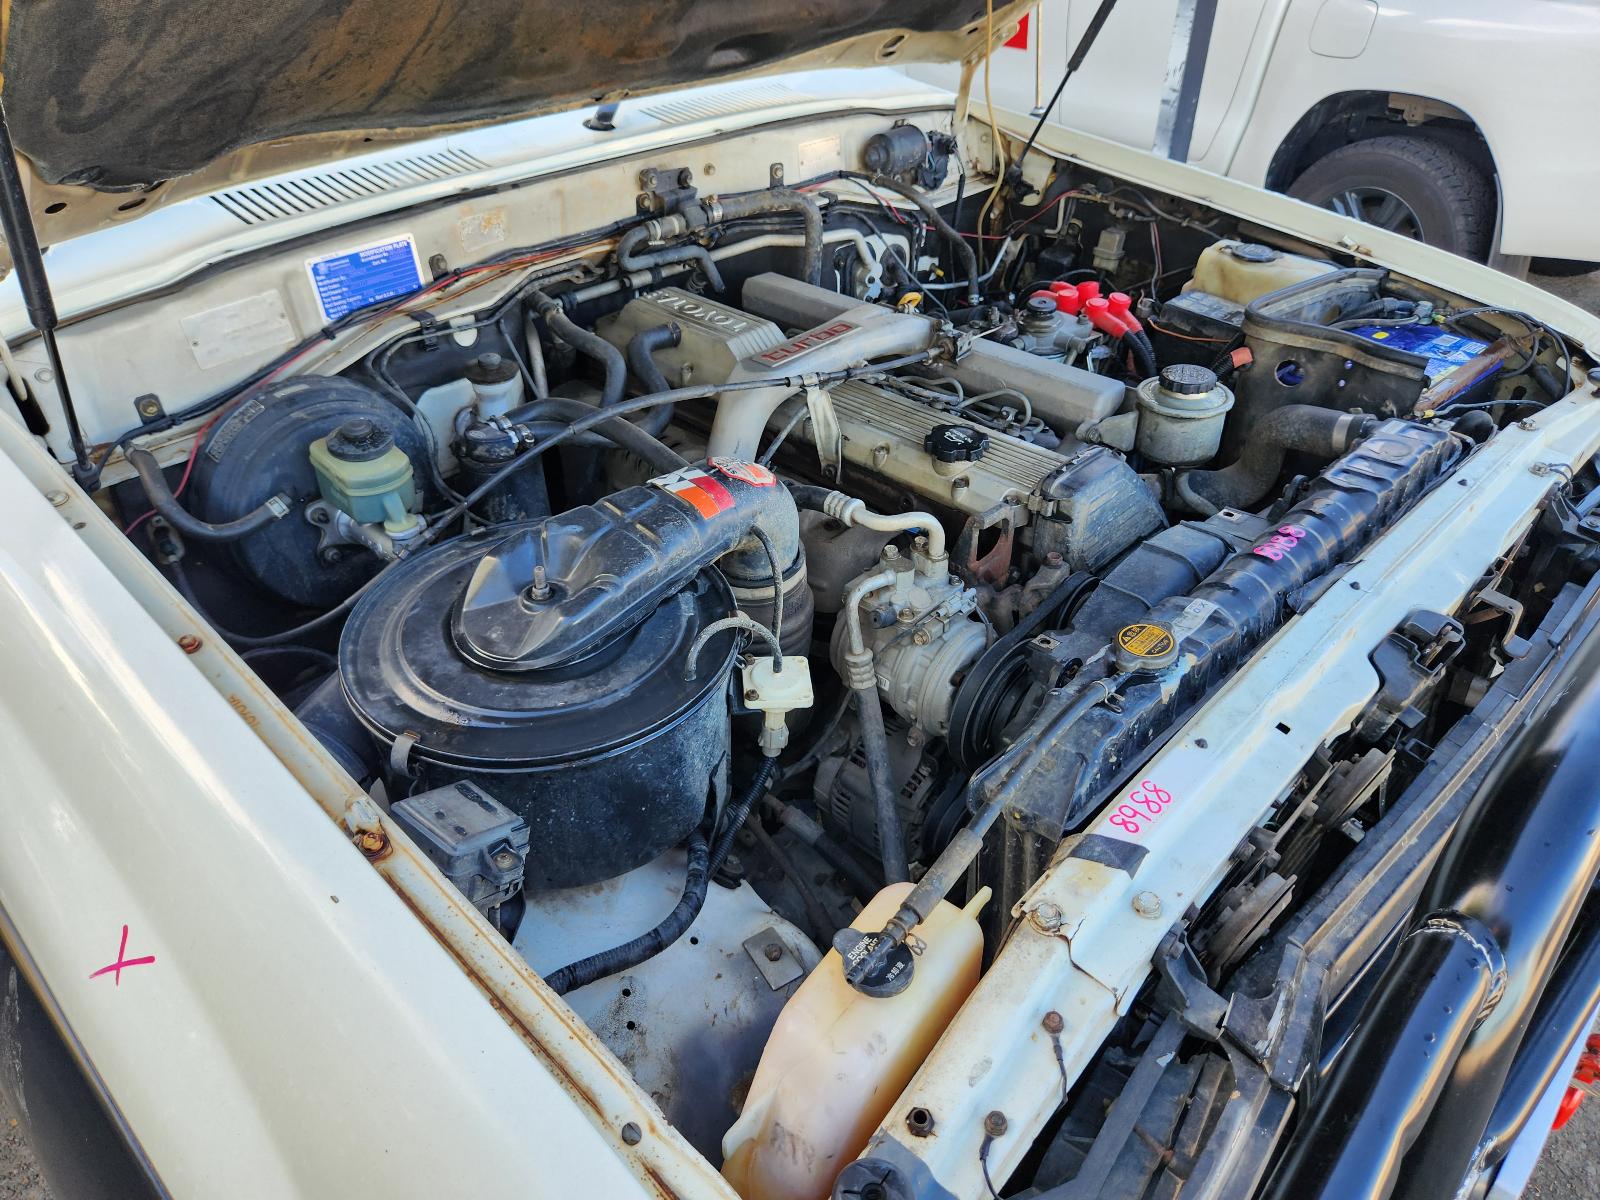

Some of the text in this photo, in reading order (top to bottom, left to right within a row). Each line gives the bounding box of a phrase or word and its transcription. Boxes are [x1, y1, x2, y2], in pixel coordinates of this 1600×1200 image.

[657, 292, 748, 332] TOYOTA
[1109, 780, 1171, 833] 8988
[847, 935, 873, 961] ENGINE
